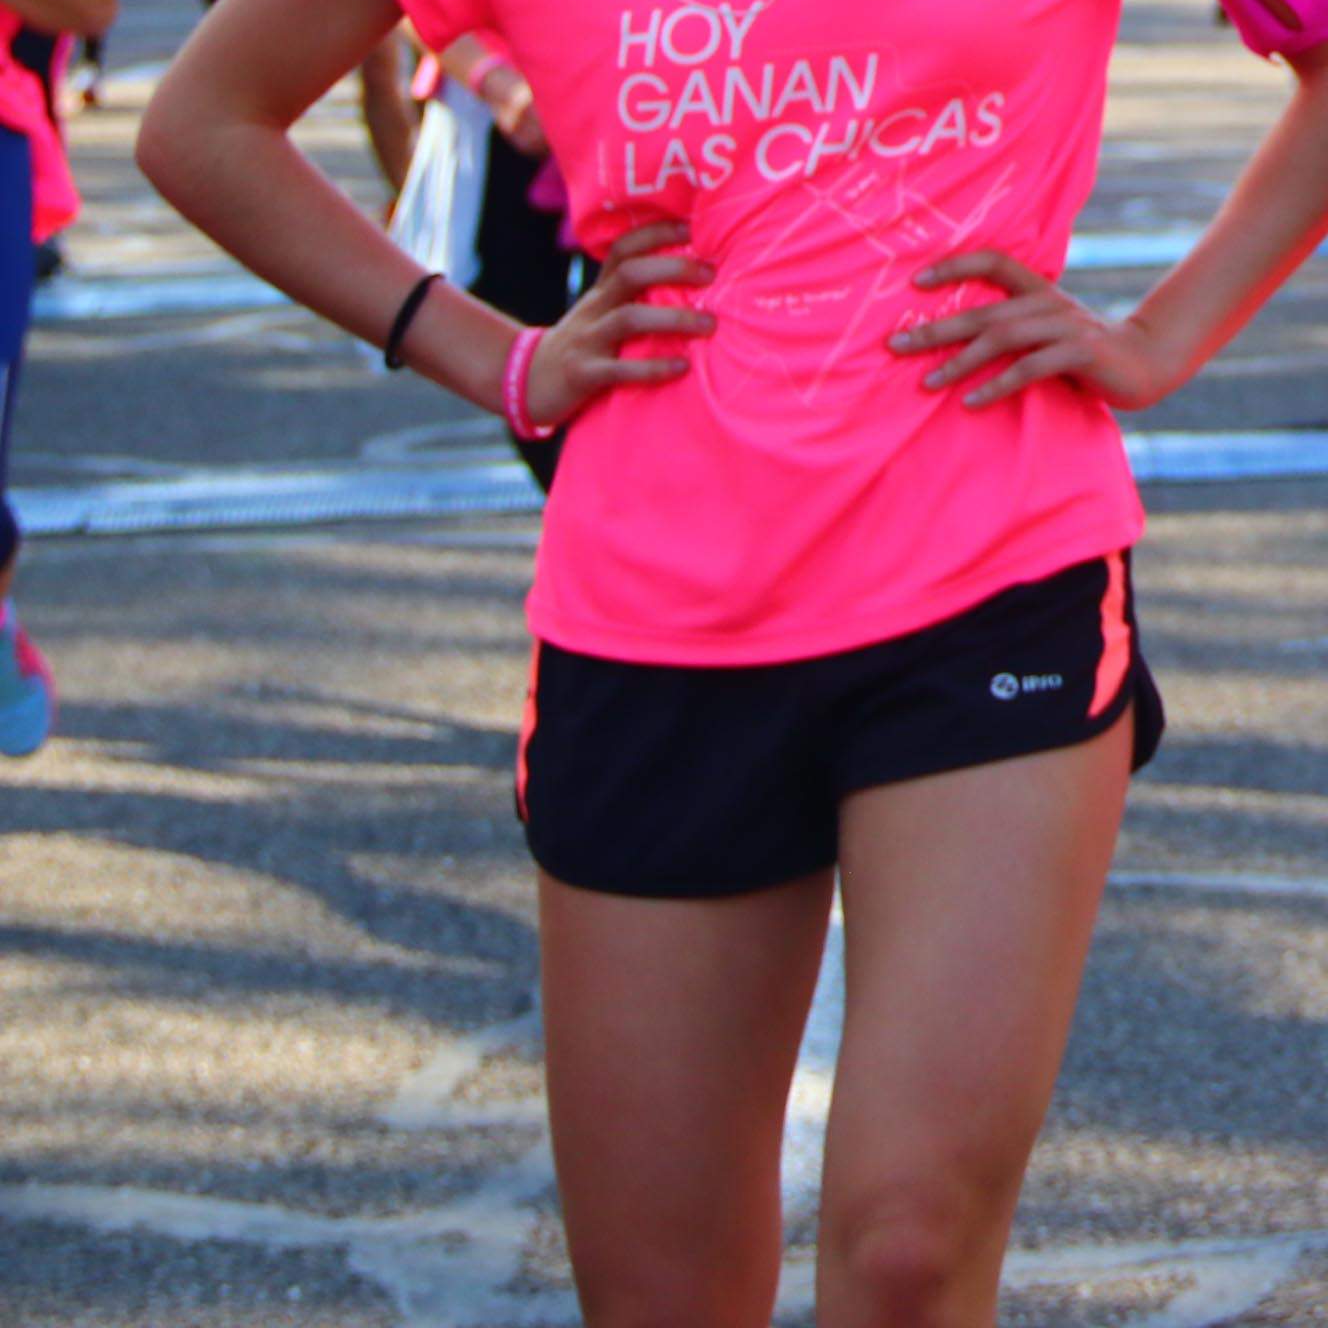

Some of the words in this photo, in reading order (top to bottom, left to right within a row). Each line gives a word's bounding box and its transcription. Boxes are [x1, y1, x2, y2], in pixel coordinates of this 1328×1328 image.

[617, 0, 764, 69] HOY
[617, 52, 878, 131] GANAN
[625, 134, 737, 196] LAS
[753, 92, 1004, 183] CHICAS
